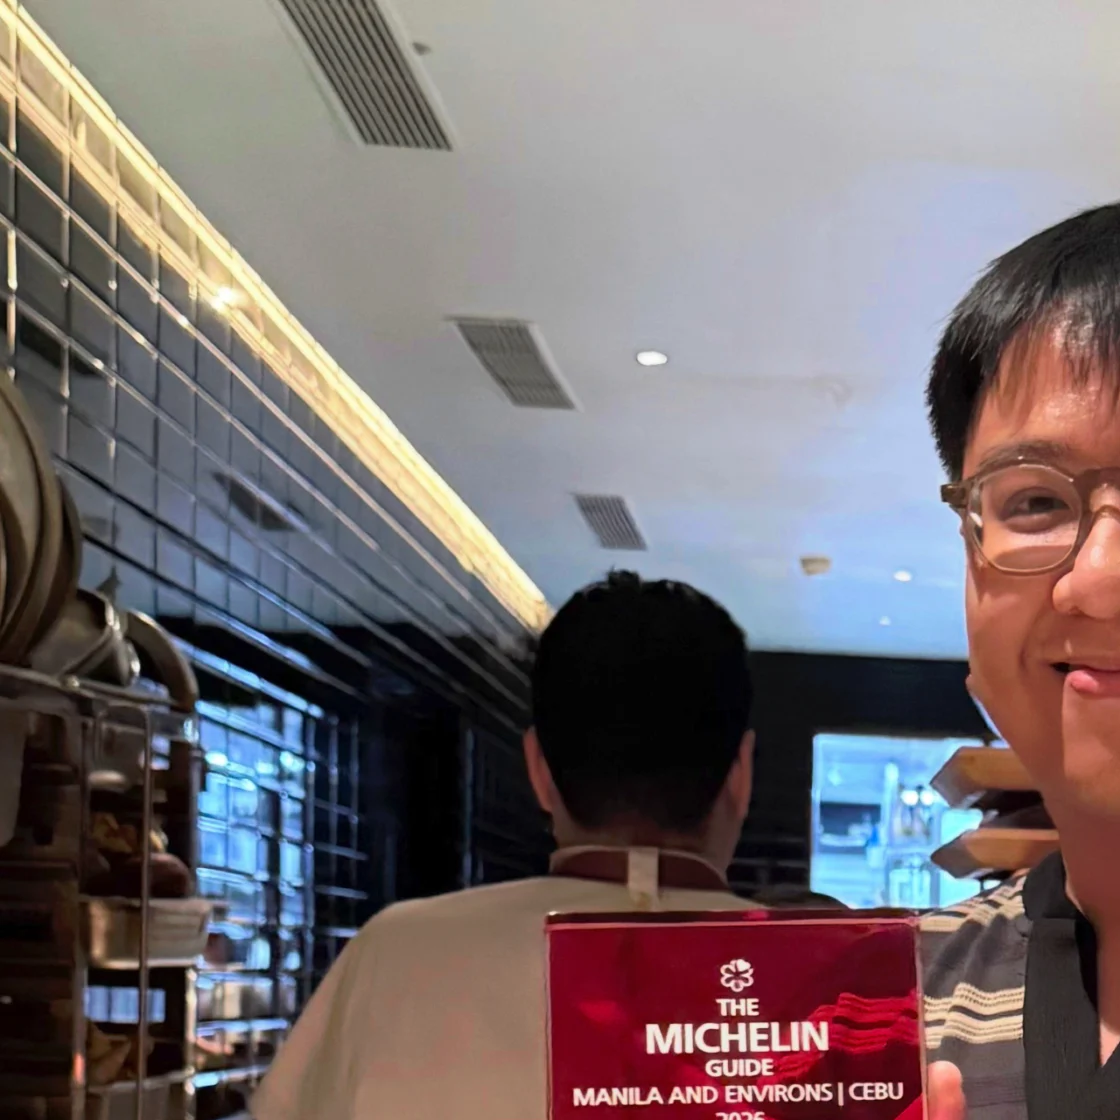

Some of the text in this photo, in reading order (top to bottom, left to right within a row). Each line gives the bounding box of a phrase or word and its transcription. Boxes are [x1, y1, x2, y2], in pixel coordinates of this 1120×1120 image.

[716, 998, 759, 1016] THE
[646, 1022, 829, 1054] MICHELIN
[705, 1059, 773, 1077] GUIDE
[573, 1087, 663, 1106] MANILA
[668, 1086, 718, 1104] AND
[725, 1083, 832, 1103] ENVIRONS
[849, 1083, 903, 1100] CEBU
